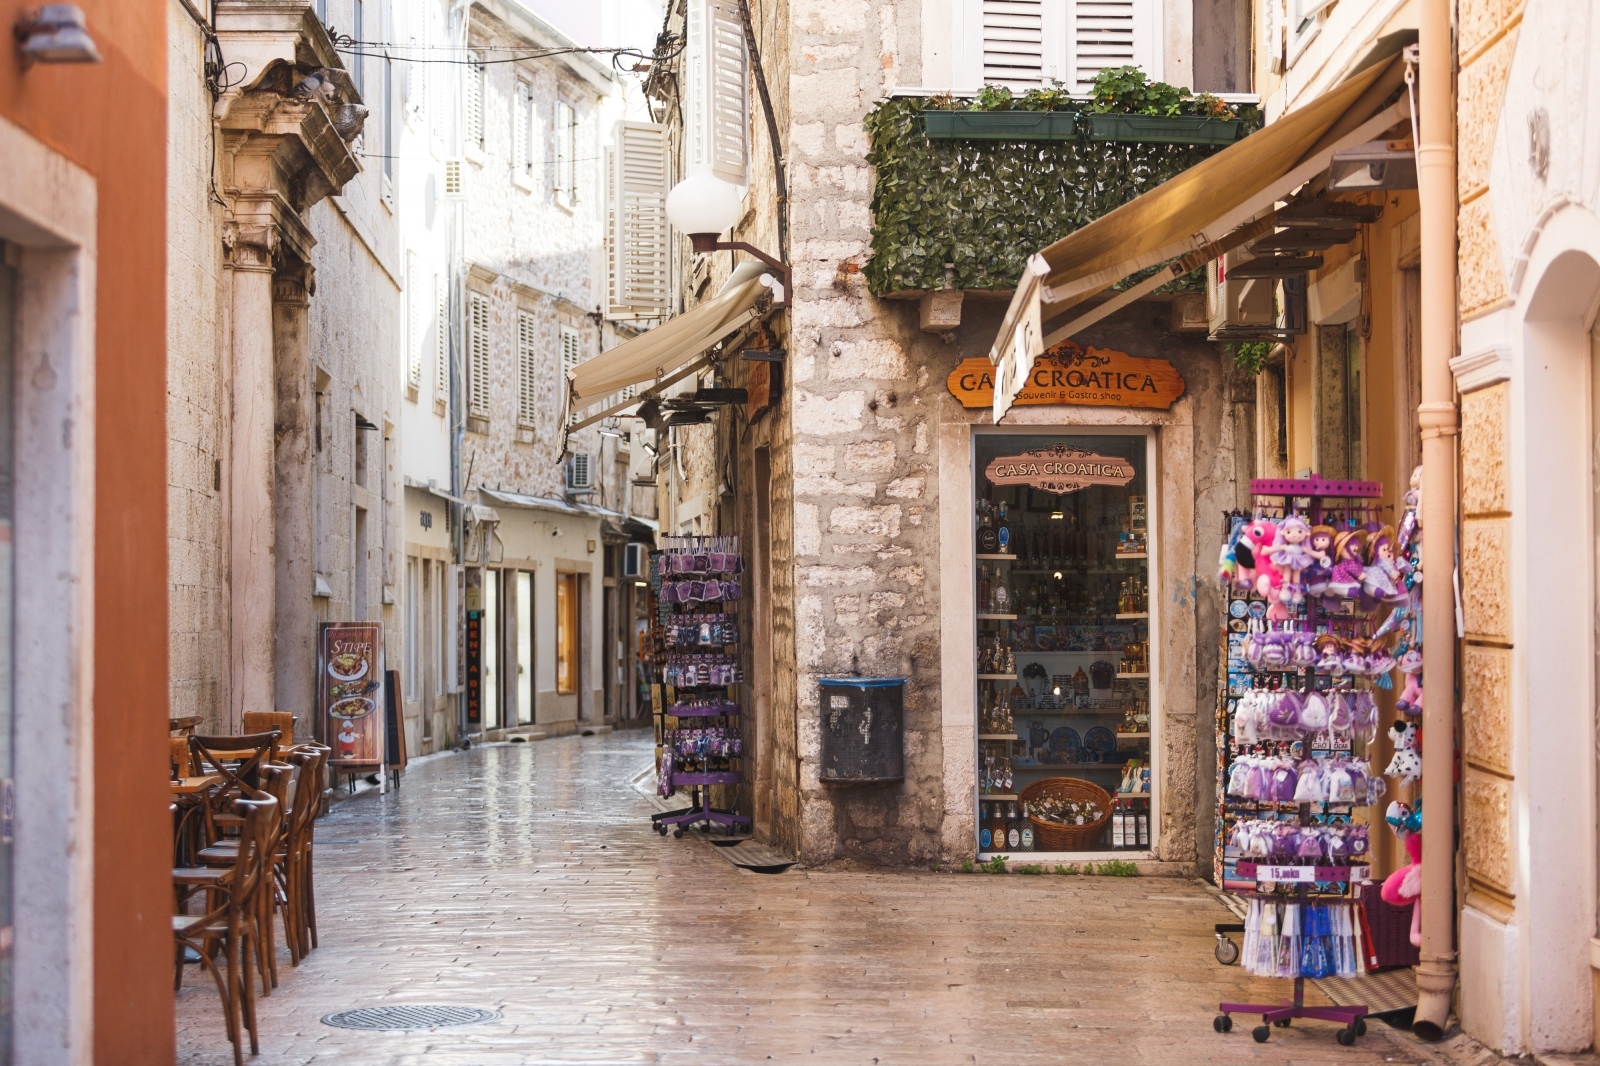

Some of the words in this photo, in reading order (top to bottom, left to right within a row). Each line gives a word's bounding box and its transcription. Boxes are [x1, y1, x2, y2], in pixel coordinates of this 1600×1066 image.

[1034, 369, 1158, 394] CROATICA
[1017, 391, 1056, 400] Souvenir
[1060, 391, 1066, 399] &
[1068, 390, 1098, 399] Gastro
[1100, 392, 1121, 401] shop
[995, 463, 1039, 477] CASA
[1043, 462, 1124, 478] CROATICA
[331, 640, 371, 653] STIPE
[469, 620, 477, 658] RENT
[469, 680, 477, 718] BIKE
